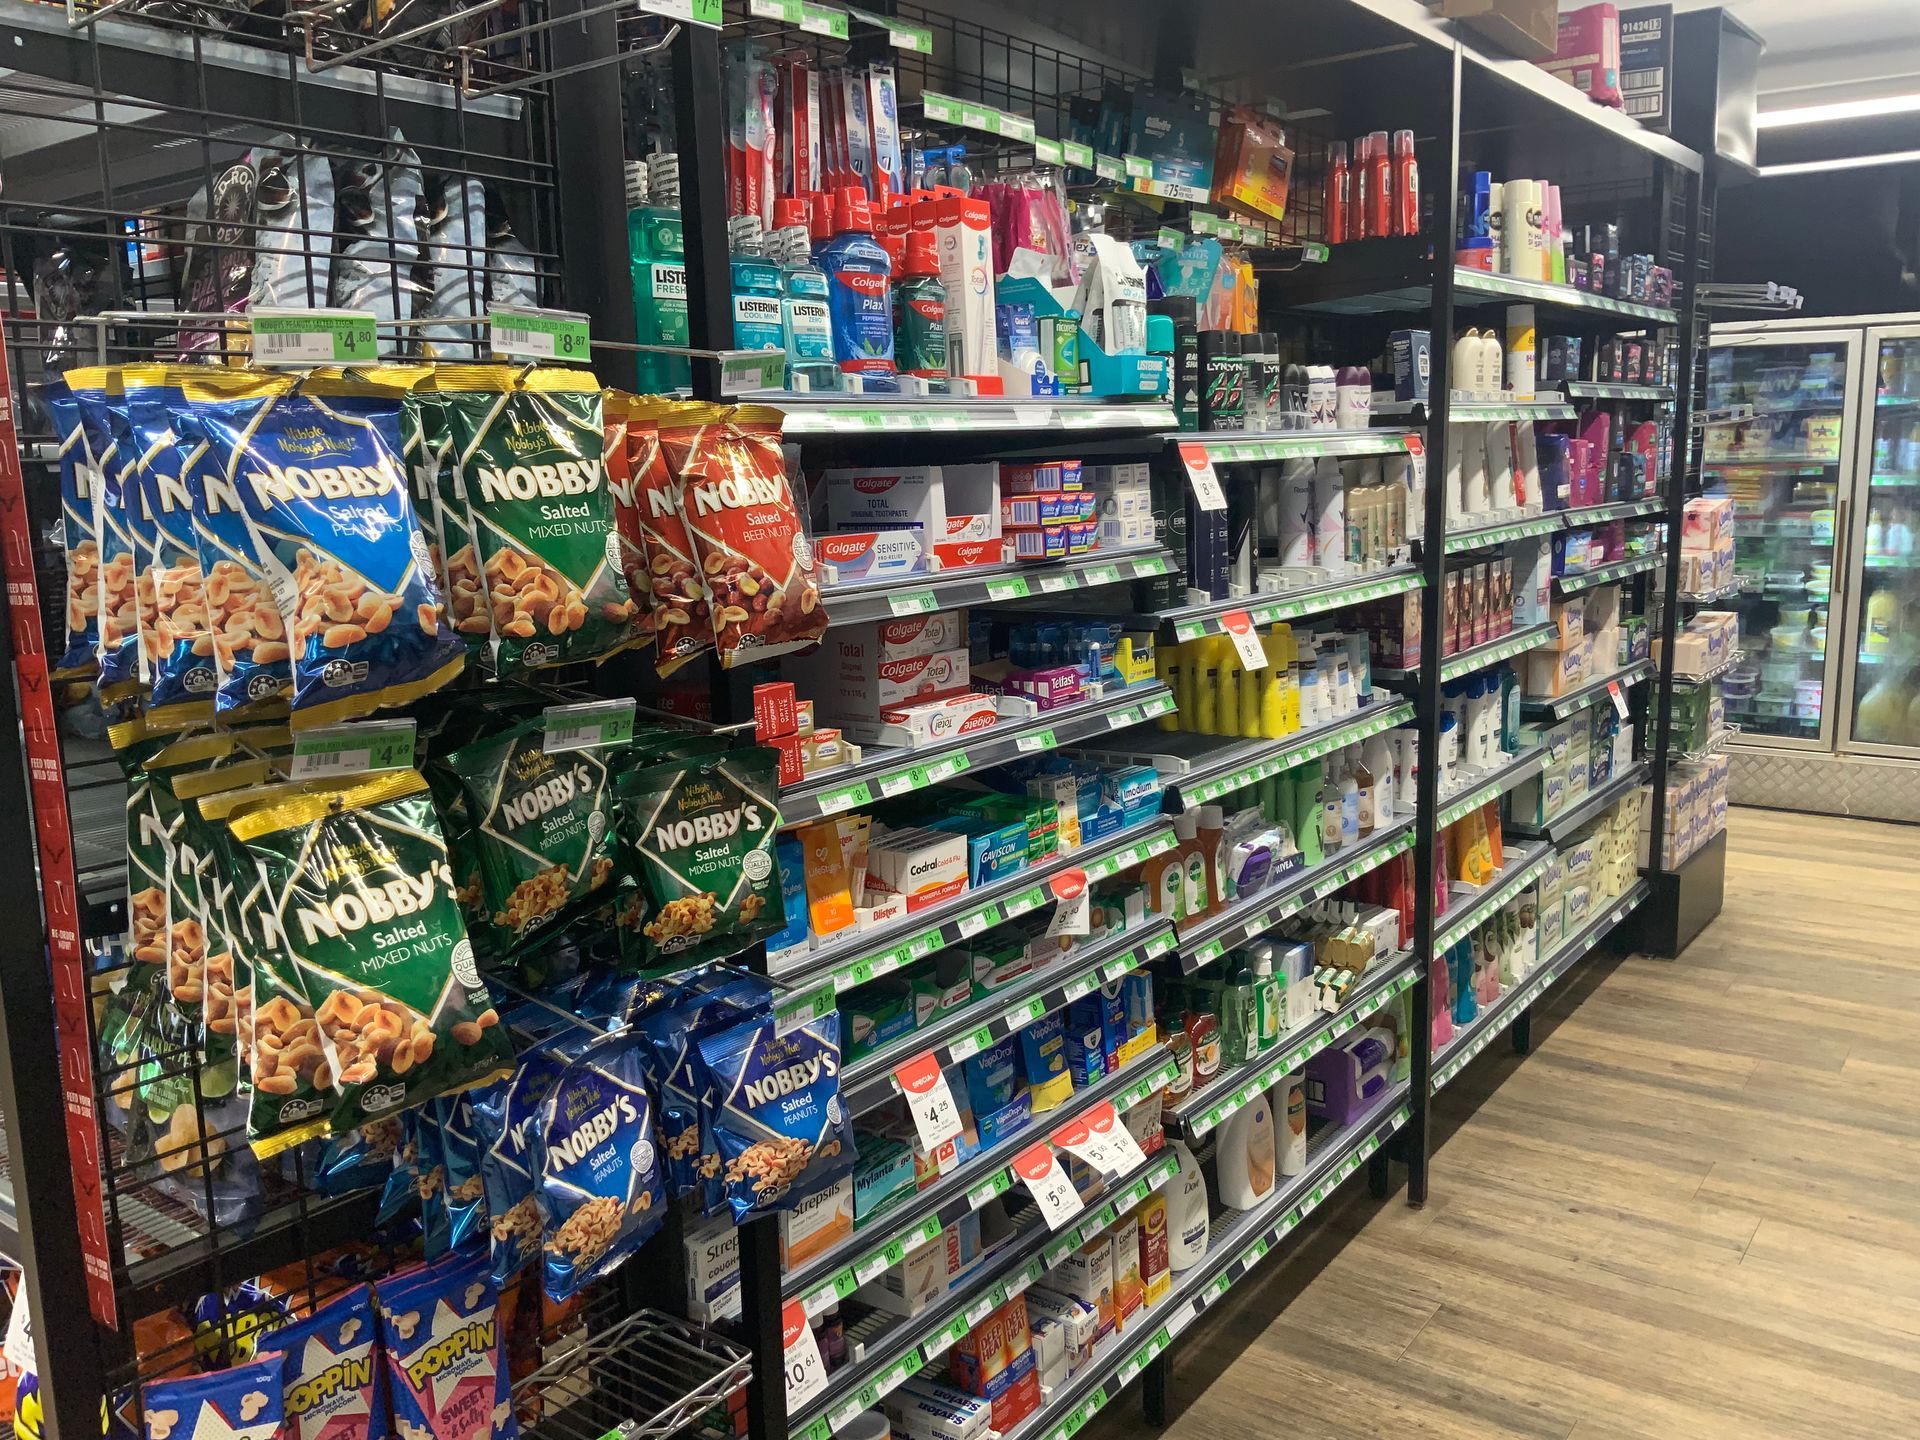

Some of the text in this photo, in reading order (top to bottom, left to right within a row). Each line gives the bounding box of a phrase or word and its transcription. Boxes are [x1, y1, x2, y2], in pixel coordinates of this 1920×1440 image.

[231, 171, 253, 193] ROC
[1170, 184, 1178, 197] 75
[964, 209, 988, 222] Colgate
[739, 301, 779, 314] LISTERINE
[862, 299, 884, 311] Plax
[929, 322, 943, 331] Plax
[338, 331, 371, 352] $4.80
[559, 334, 585, 353] $8.87
[505, 435, 546, 451] Nobby's
[857, 479, 893, 489] Colgate
[541, 502, 590, 520] Salted
[867, 500, 889, 509] TOTAL
[875, 509, 908, 518] TOOTHPASTE
[746, 511, 781, 525] Salted
[529, 520, 608, 540] MIXED NUTS
[743, 524, 792, 542] BEER NUTS
[971, 523, 982, 532] Total
[826, 540, 867, 555] Colgate
[877, 541, 916, 554] SENSITIVE
[957, 545, 984, 557] Colgate
[878, 553, 903, 561] PRO-RELIEF
[7, 583, 33, 594] FEED YOUR
[23, 595, 34, 605] SIDE
[887, 621, 940, 639] Colgate Total
[838, 642, 864, 658] Total
[881, 661, 946, 677] Colgate Total
[1051, 674, 1075, 690] Telfast
[769, 699, 777, 735] Colgate
[882, 713, 905, 721] Colgate
[935, 714, 996, 730] Total Colgate
[608, 720, 631, 738] $3.29
[377, 744, 409, 765] $4.69
[31, 758, 57, 770] FEED YOUR
[33, 769, 58, 781] WILD SIDE
[502, 764, 592, 830] NOBBY'S
[1123, 782, 1152, 799] Imodium
[541, 810, 575, 832] Salted
[656, 802, 762, 852] NOBBY'S
[540, 820, 587, 850] MIXED NUTS
[695, 845, 730, 862] Salted
[981, 843, 1016, 863] GAVISCON
[688, 856, 741, 877] MIXED NUTS
[745, 860, 770, 869] QUALITY
[910, 858, 938, 876] Codral
[937, 860, 949, 869] Cold
[952, 855, 961, 864] Flu
[919, 890, 942, 902] POWERFUL
[1062, 885, 1081, 895] SPECIAL
[297, 860, 457, 944] NOBBY'S
[873, 905, 897, 921] Blistex
[52, 929, 75, 941] RE-ORDER
[372, 920, 427, 950] Salted
[361, 932, 453, 974] MIXED NUTS
[918, 1000, 935, 1013] Panadol
[744, 1050, 838, 1109] NOBBY'S
[912, 1073, 936, 1089] SPECIAL
[67, 1091, 91, 1107] FEED YOUR
[781, 1093, 813, 1113] Salted
[68, 1103, 92, 1119] WILD SIDE
[783, 1106, 818, 1126] PEANUTS
[924, 1100, 949, 1124] $4.25
[996, 1105, 1023, 1125] VapoDrops
[1094, 1118, 1111, 1129] SPECIAL
[550, 1095, 637, 1172] NOBBY'S
[1066, 1132, 1087, 1144] SPECIAL
[590, 1145, 617, 1172] Salted
[593, 1156, 623, 1185] PEANUTS
[856, 1163, 894, 1192] Mylanta
[1028, 1162, 1048, 1176] SPECIAL
[792, 1183, 840, 1220] Strepsils
[1118, 1224, 1137, 1244] Codral
[707, 1234, 739, 1263] Strep
[1091, 1247, 1110, 1267] Codral
[85, 1253, 96, 1265] FEED
[1004, 1304, 1024, 1329] DEEP
[783, 1325, 799, 1339] CIAL
[980, 1323, 1001, 1349] DEEP
[1007, 1315, 1026, 1341] HEAT
[982, 1335, 1003, 1362] HEAT
[454, 1357, 483, 1378] POPCORN
[1011, 1349, 1032, 1369] ORIGINAL
[255, 1376, 271, 1384] 100g
[435, 1358, 473, 1384] MICROWAVE
[986, 1370, 1009, 1390] ORIGINAL
[304, 1395, 345, 1421] MICROWAVE
[325, 1395, 357, 1416] POPCORN
[442, 1387, 486, 1426] SWEET
[933, 1390, 981, 1411] Savlon
[918, 1402, 966, 1426] Savlon
[451, 1409, 487, 1439] & Salty
